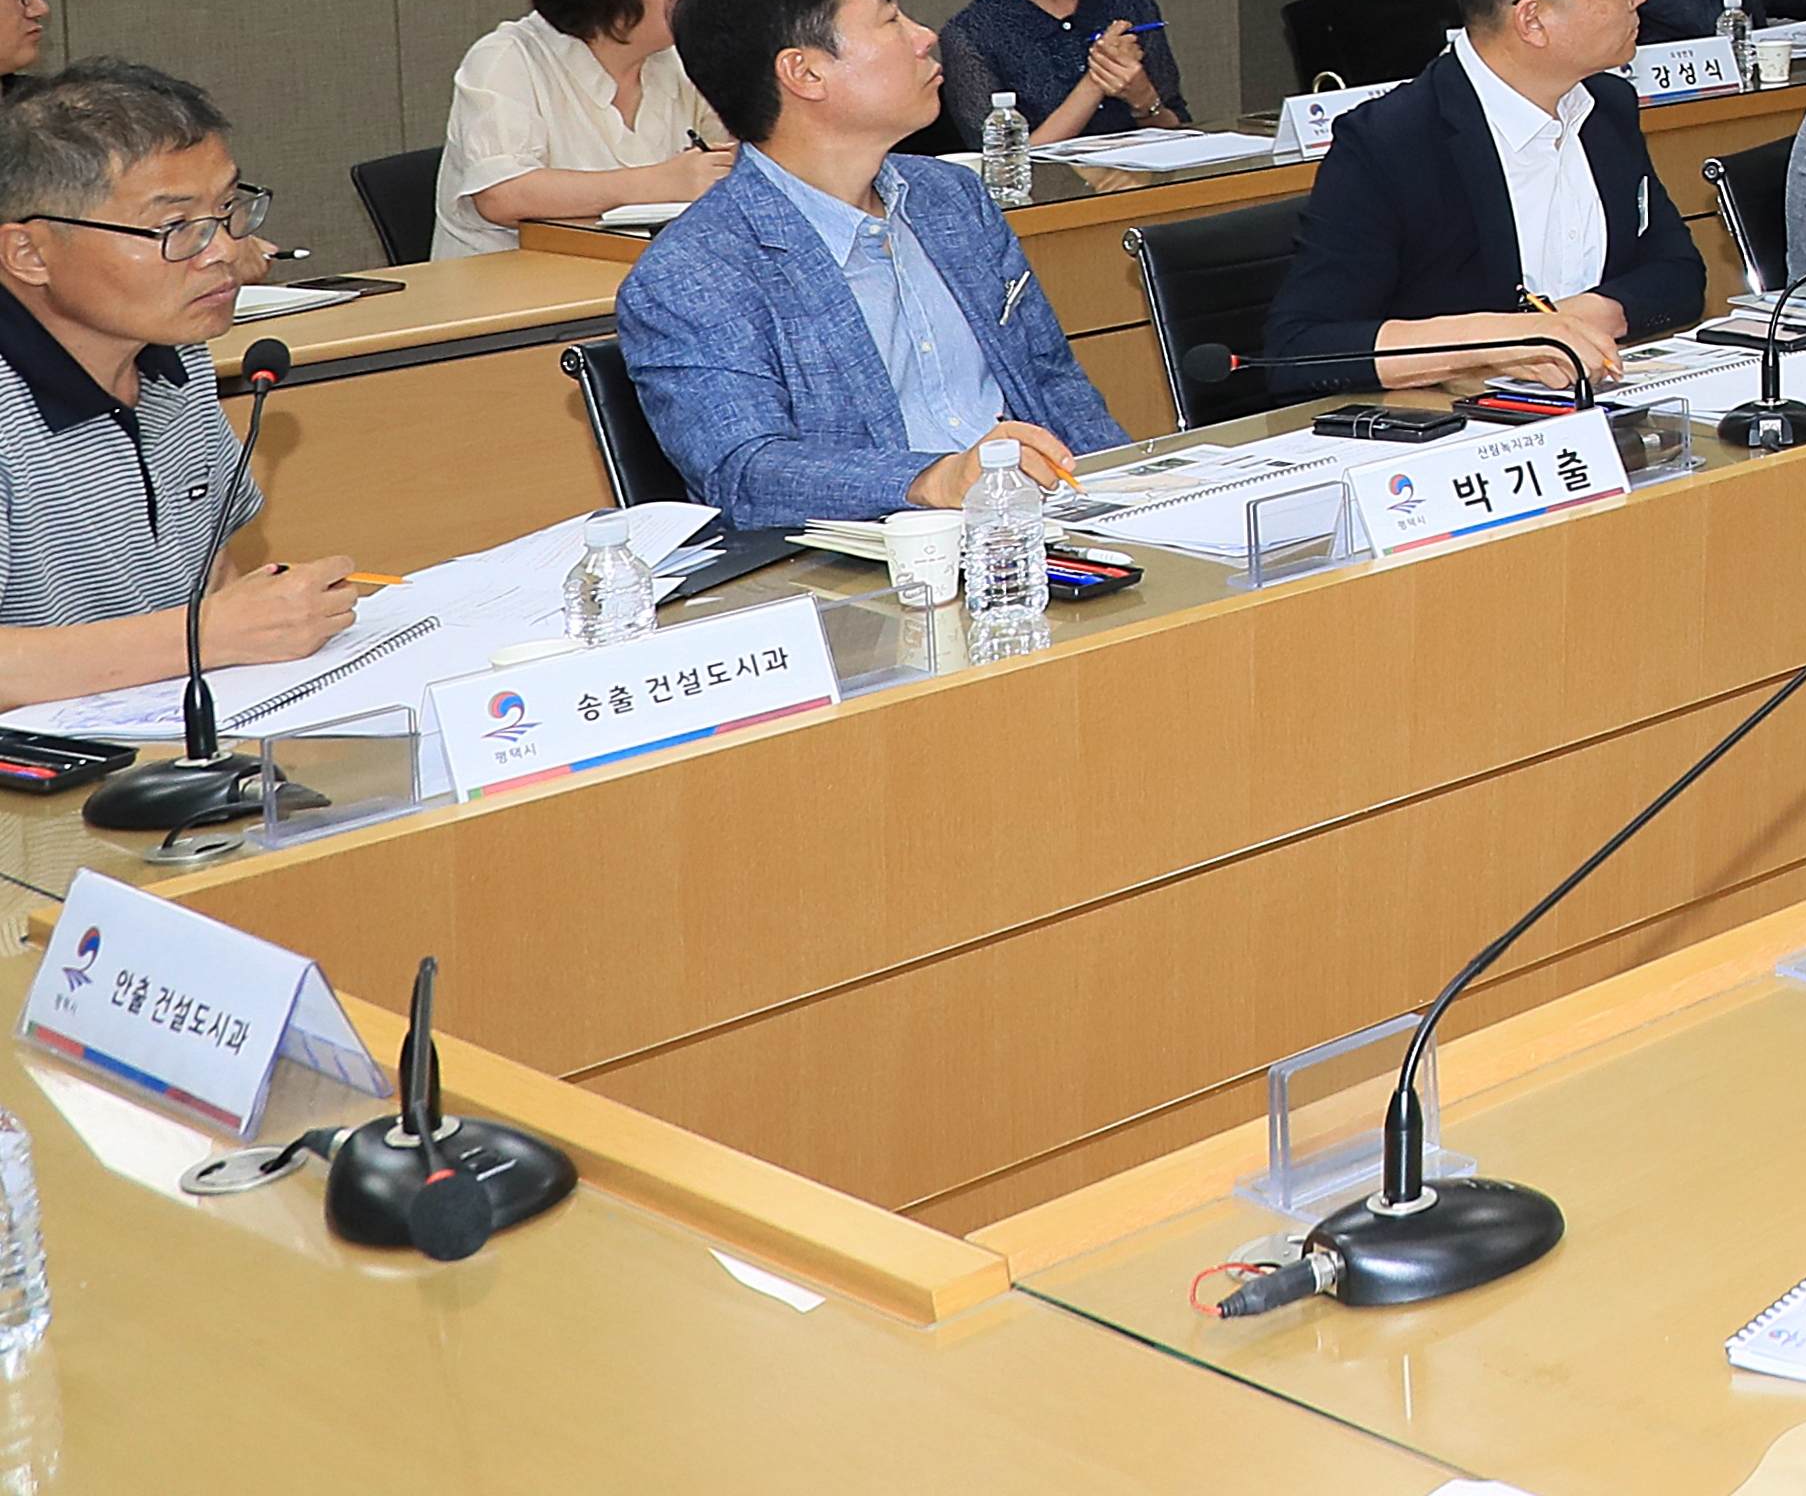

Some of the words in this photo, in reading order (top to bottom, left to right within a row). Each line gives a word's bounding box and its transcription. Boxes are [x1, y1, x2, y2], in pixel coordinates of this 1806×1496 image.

[1651, 58, 1724, 90] 강성식
[1477, 433, 1545, 459] 산림녹지과장
[1451, 448, 1592, 514] 박기출
[1396, 514, 1427, 531] 평택시
[576, 684, 634, 722] 송출
[645, 647, 790, 704] 건설도시과
[493, 743, 537, 765] 평택시
[111, 968, 151, 1016] 안출
[151, 986, 251, 1056] 건설도시과
